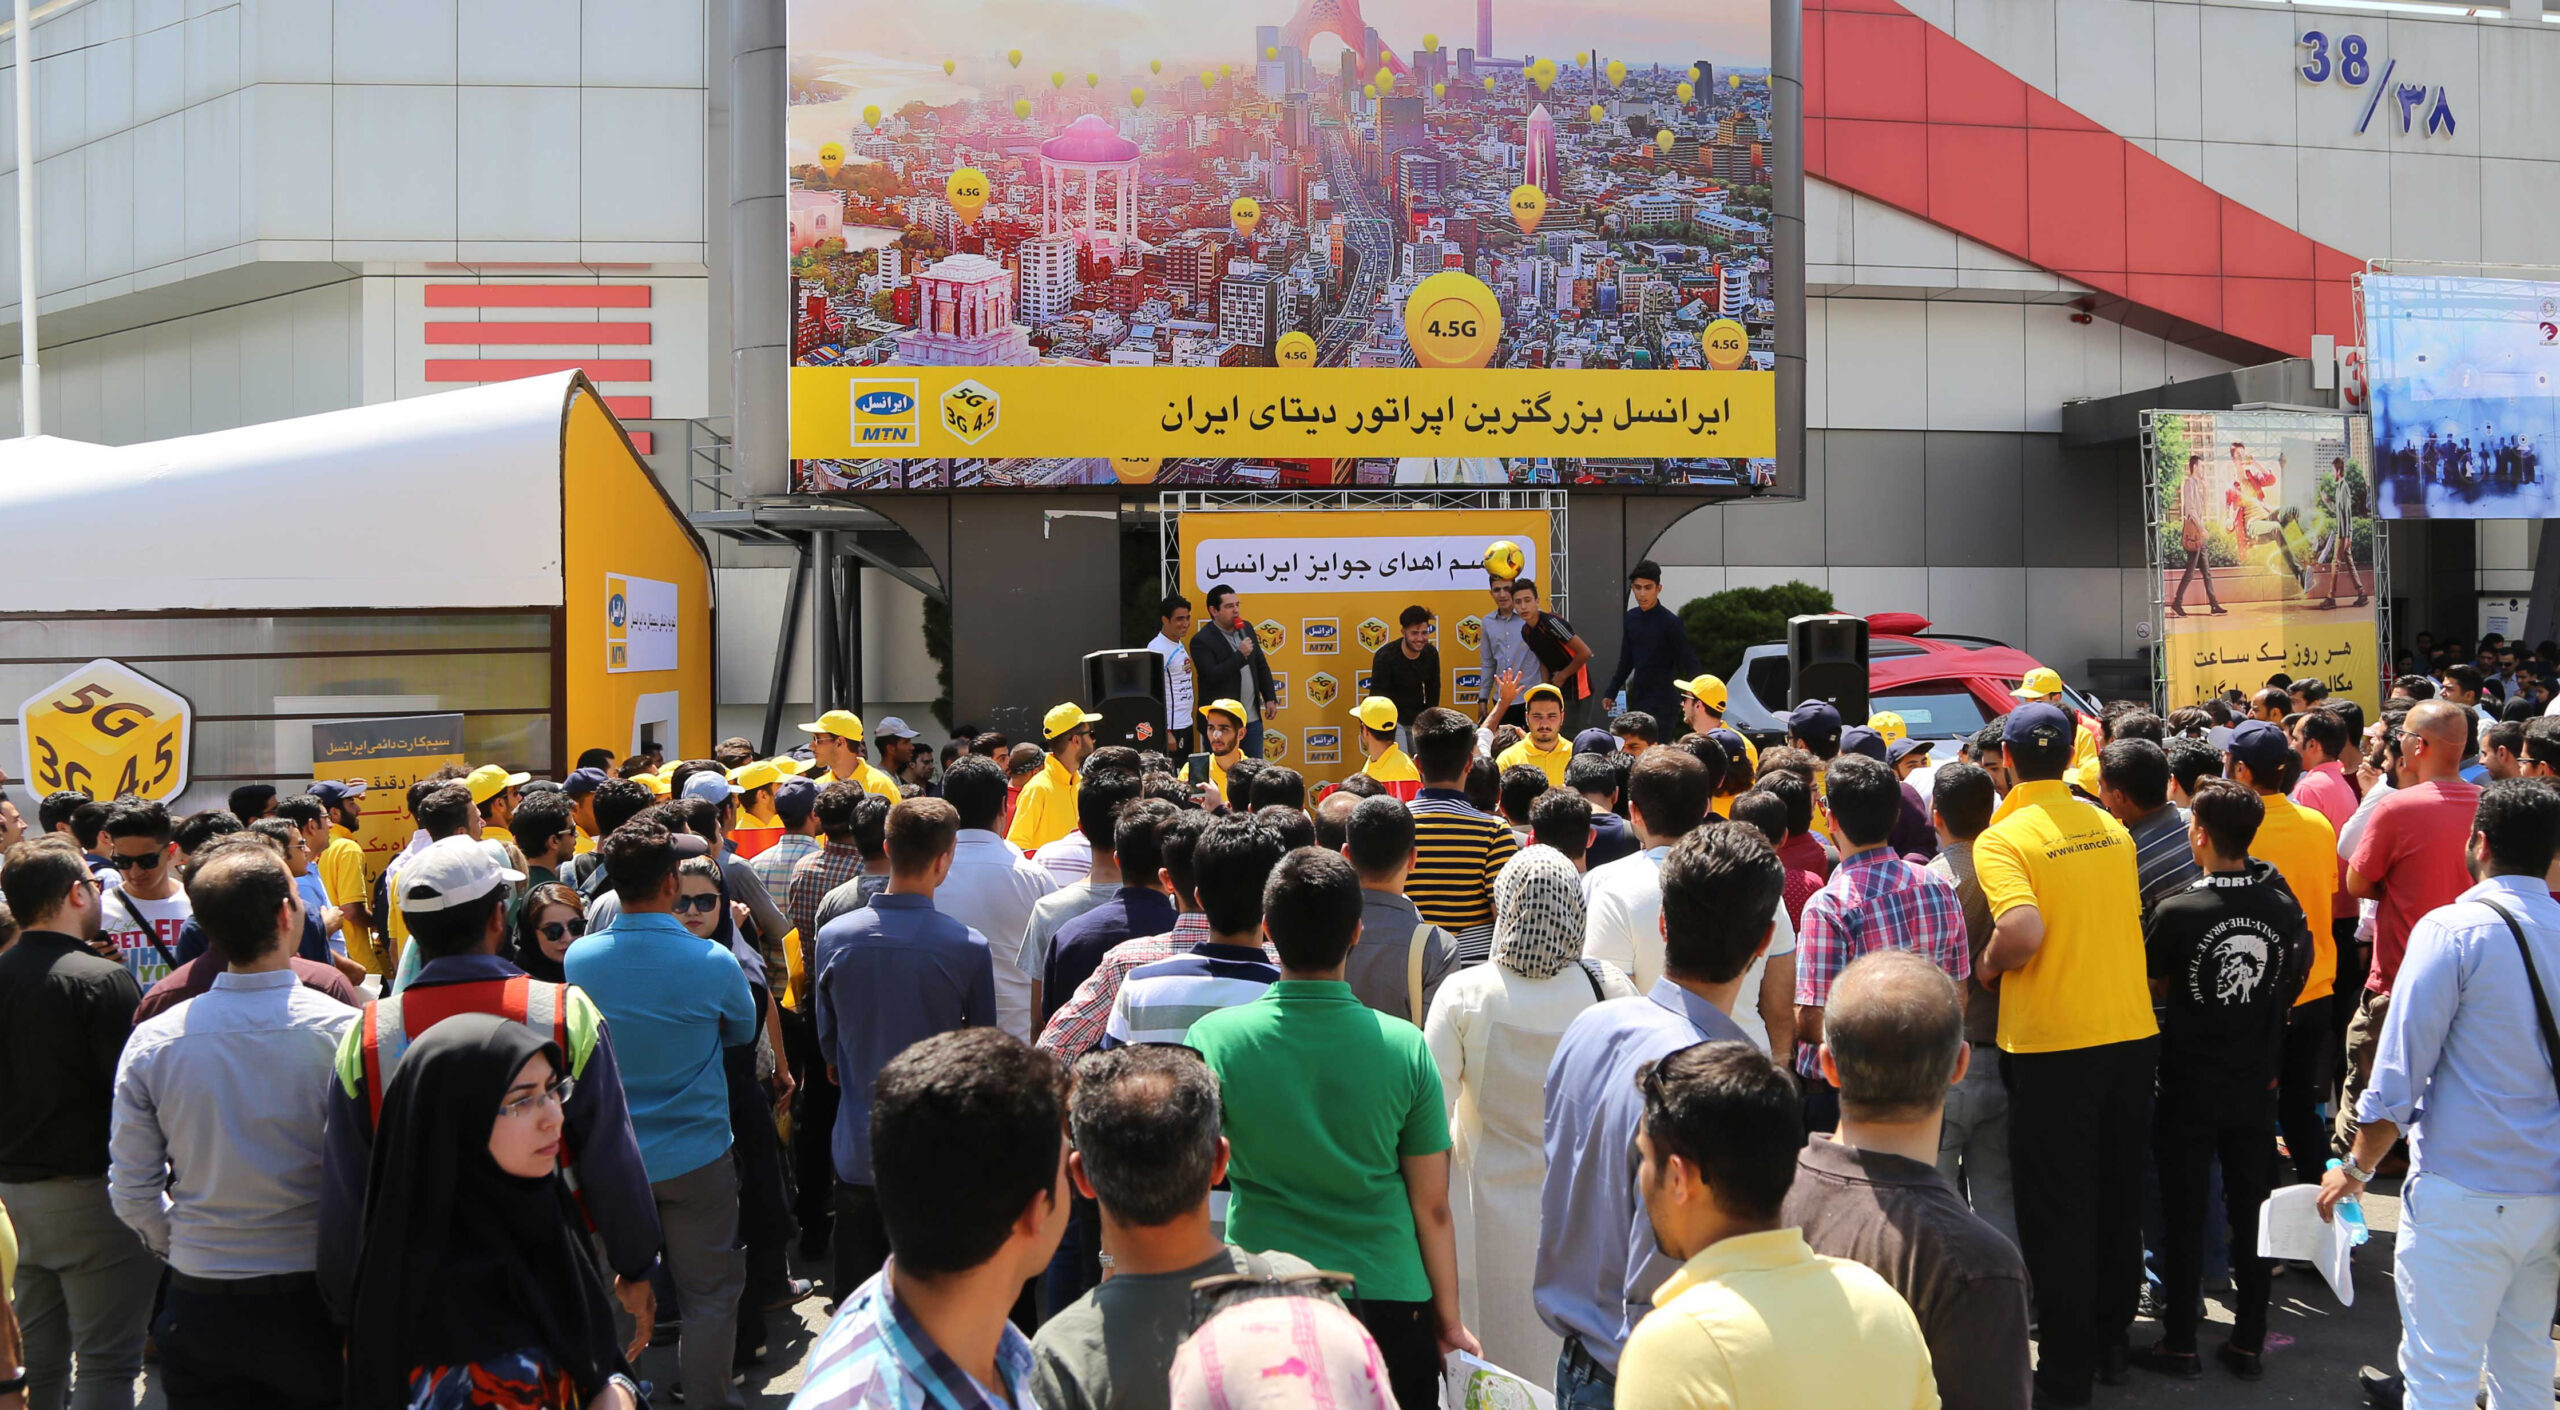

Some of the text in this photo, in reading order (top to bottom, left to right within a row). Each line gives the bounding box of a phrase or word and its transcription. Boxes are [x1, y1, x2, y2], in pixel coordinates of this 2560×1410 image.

[956, 188, 980, 197] 4.5G
[1428, 320, 1477, 337] 4.5G
[1712, 340, 1739, 350] 4.5G
[1284, 351, 1307, 360] 4.5G
[863, 396, 908, 413] ایرانسل
[952, 388, 988, 407] 5G
[946, 406, 968, 433] 3G
[1161, 391, 1729, 436] ایرانسل بزرگترین اپراتور دیتای ایران
[862, 428, 908, 440] MTN
[1206, 552, 1297, 581] ایرانسل
[1304, 552, 1371, 581] جوایز
[1379, 550, 1441, 577] اهدای
[1309, 644, 1333, 652] MTN
[2194, 641, 2352, 668] هر روز یک ساعت
[52, 683, 155, 738] 5G
[326, 740, 367, 756] ایرانسل
[1310, 753, 1335, 761] MTN
[35, 736, 94, 800] 3G
[114, 732, 173, 801] 4.5
